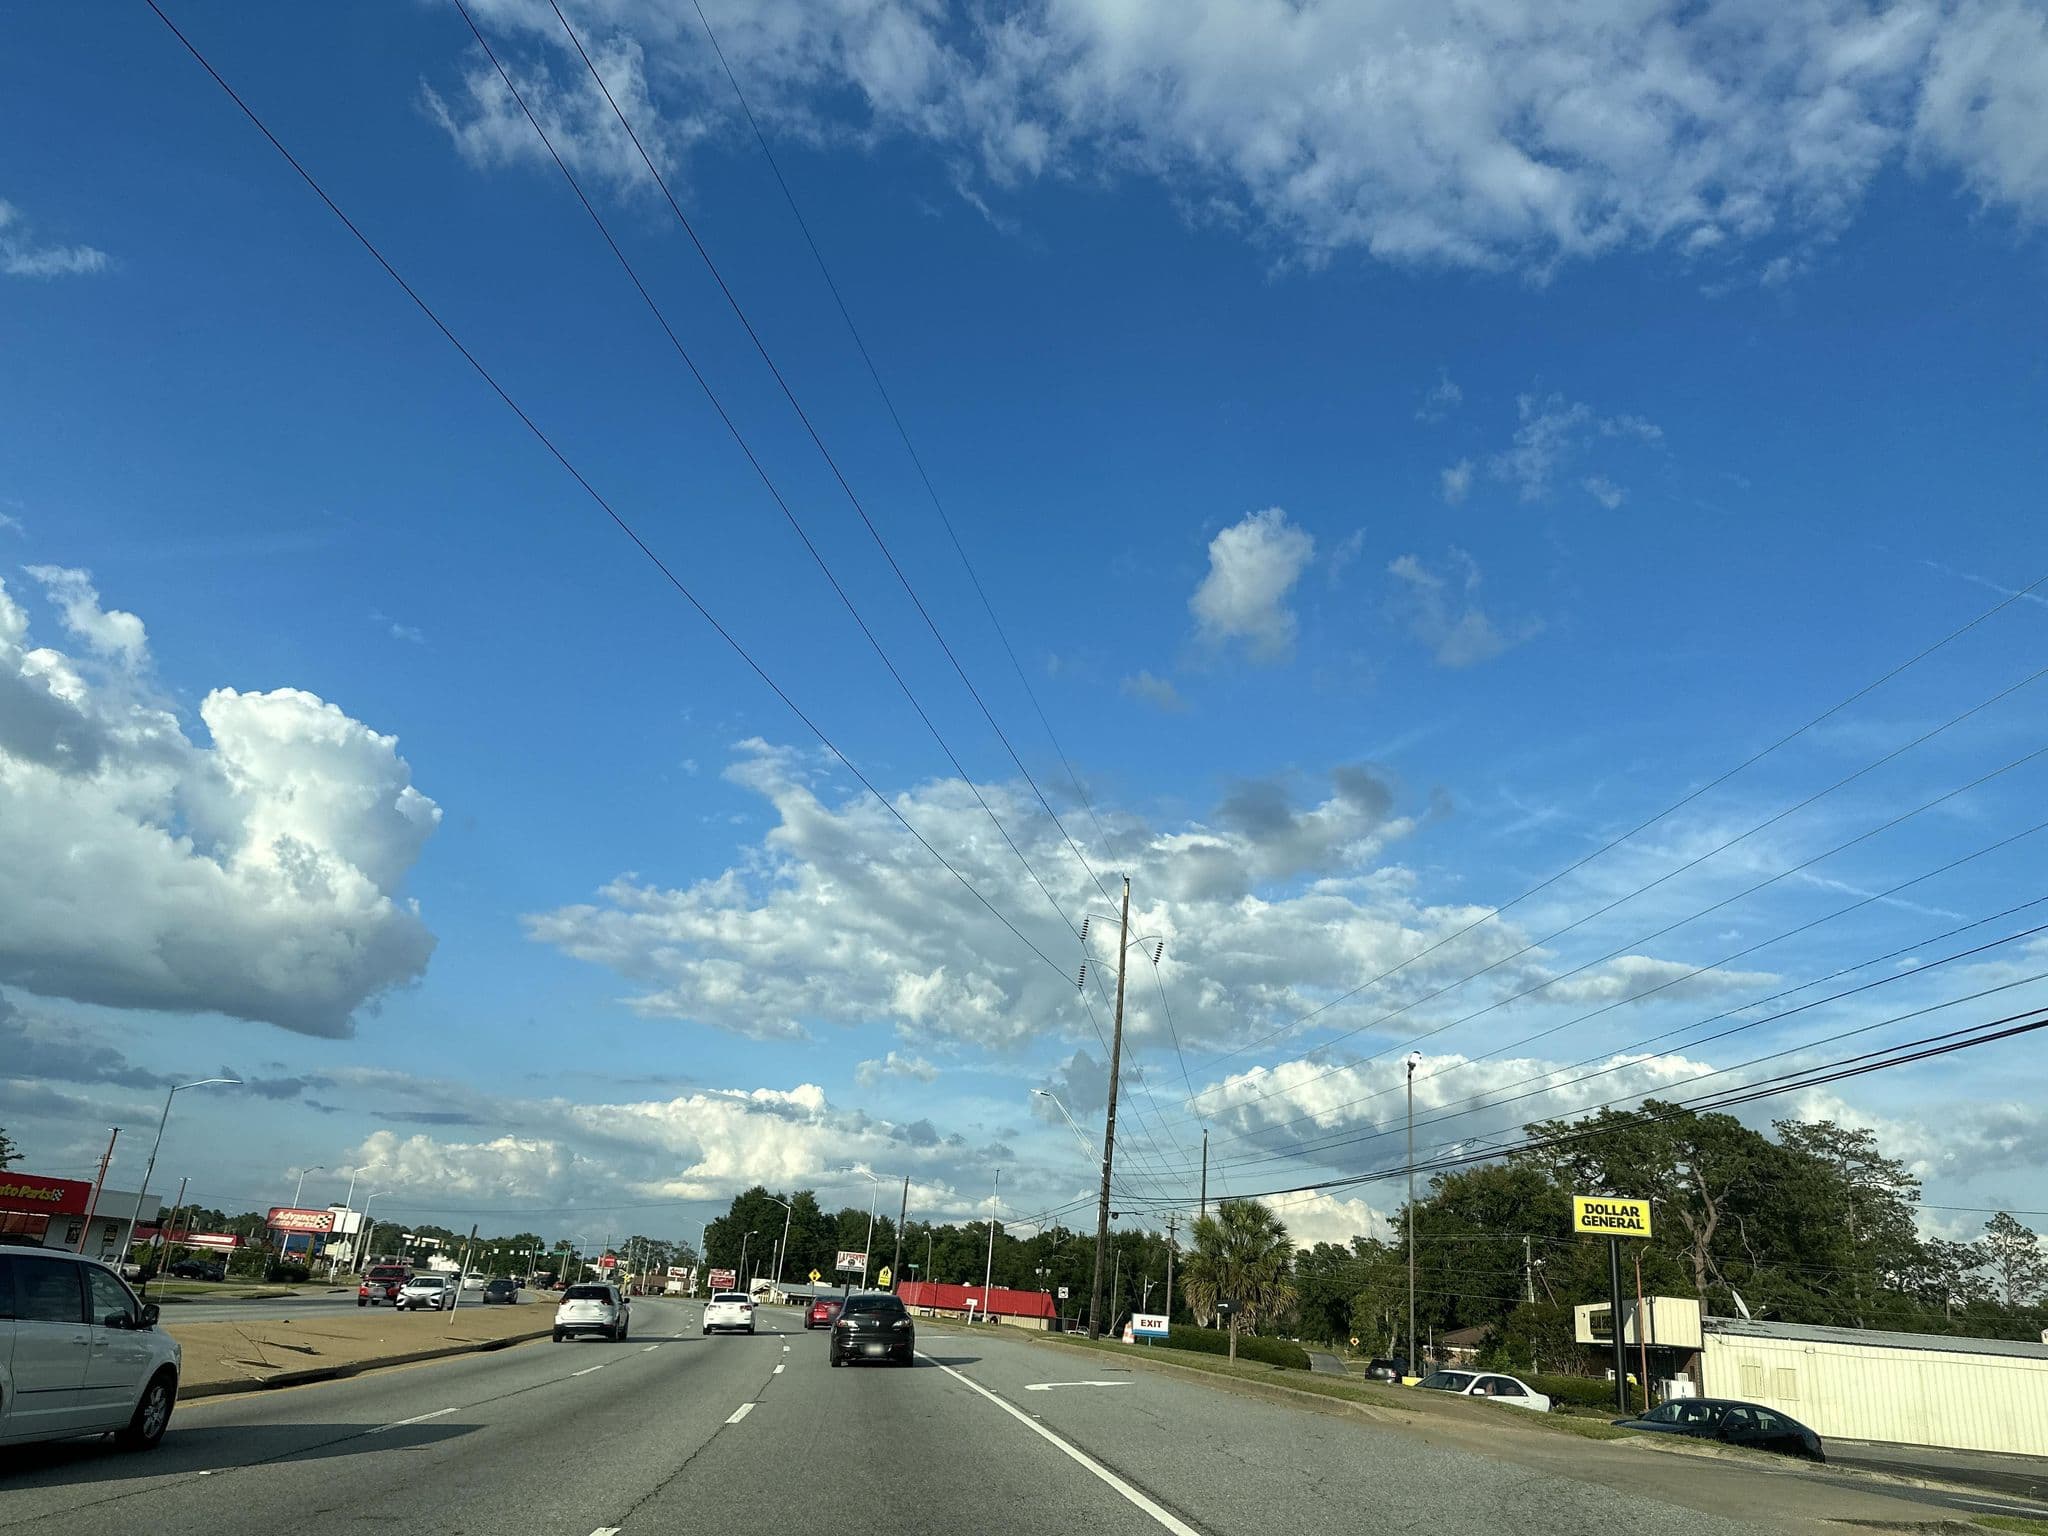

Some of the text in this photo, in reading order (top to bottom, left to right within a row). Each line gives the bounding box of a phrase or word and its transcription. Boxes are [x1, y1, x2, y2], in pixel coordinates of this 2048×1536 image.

[19, 1185, 52, 1201] Parts
[1584, 1203, 1640, 1217] DOLLAR
[275, 1211, 317, 1223] Advance
[1581, 1215, 1645, 1230] GENERAL
[291, 1220, 315, 1229] Parts
[1140, 1319, 1163, 1328] EXIT
